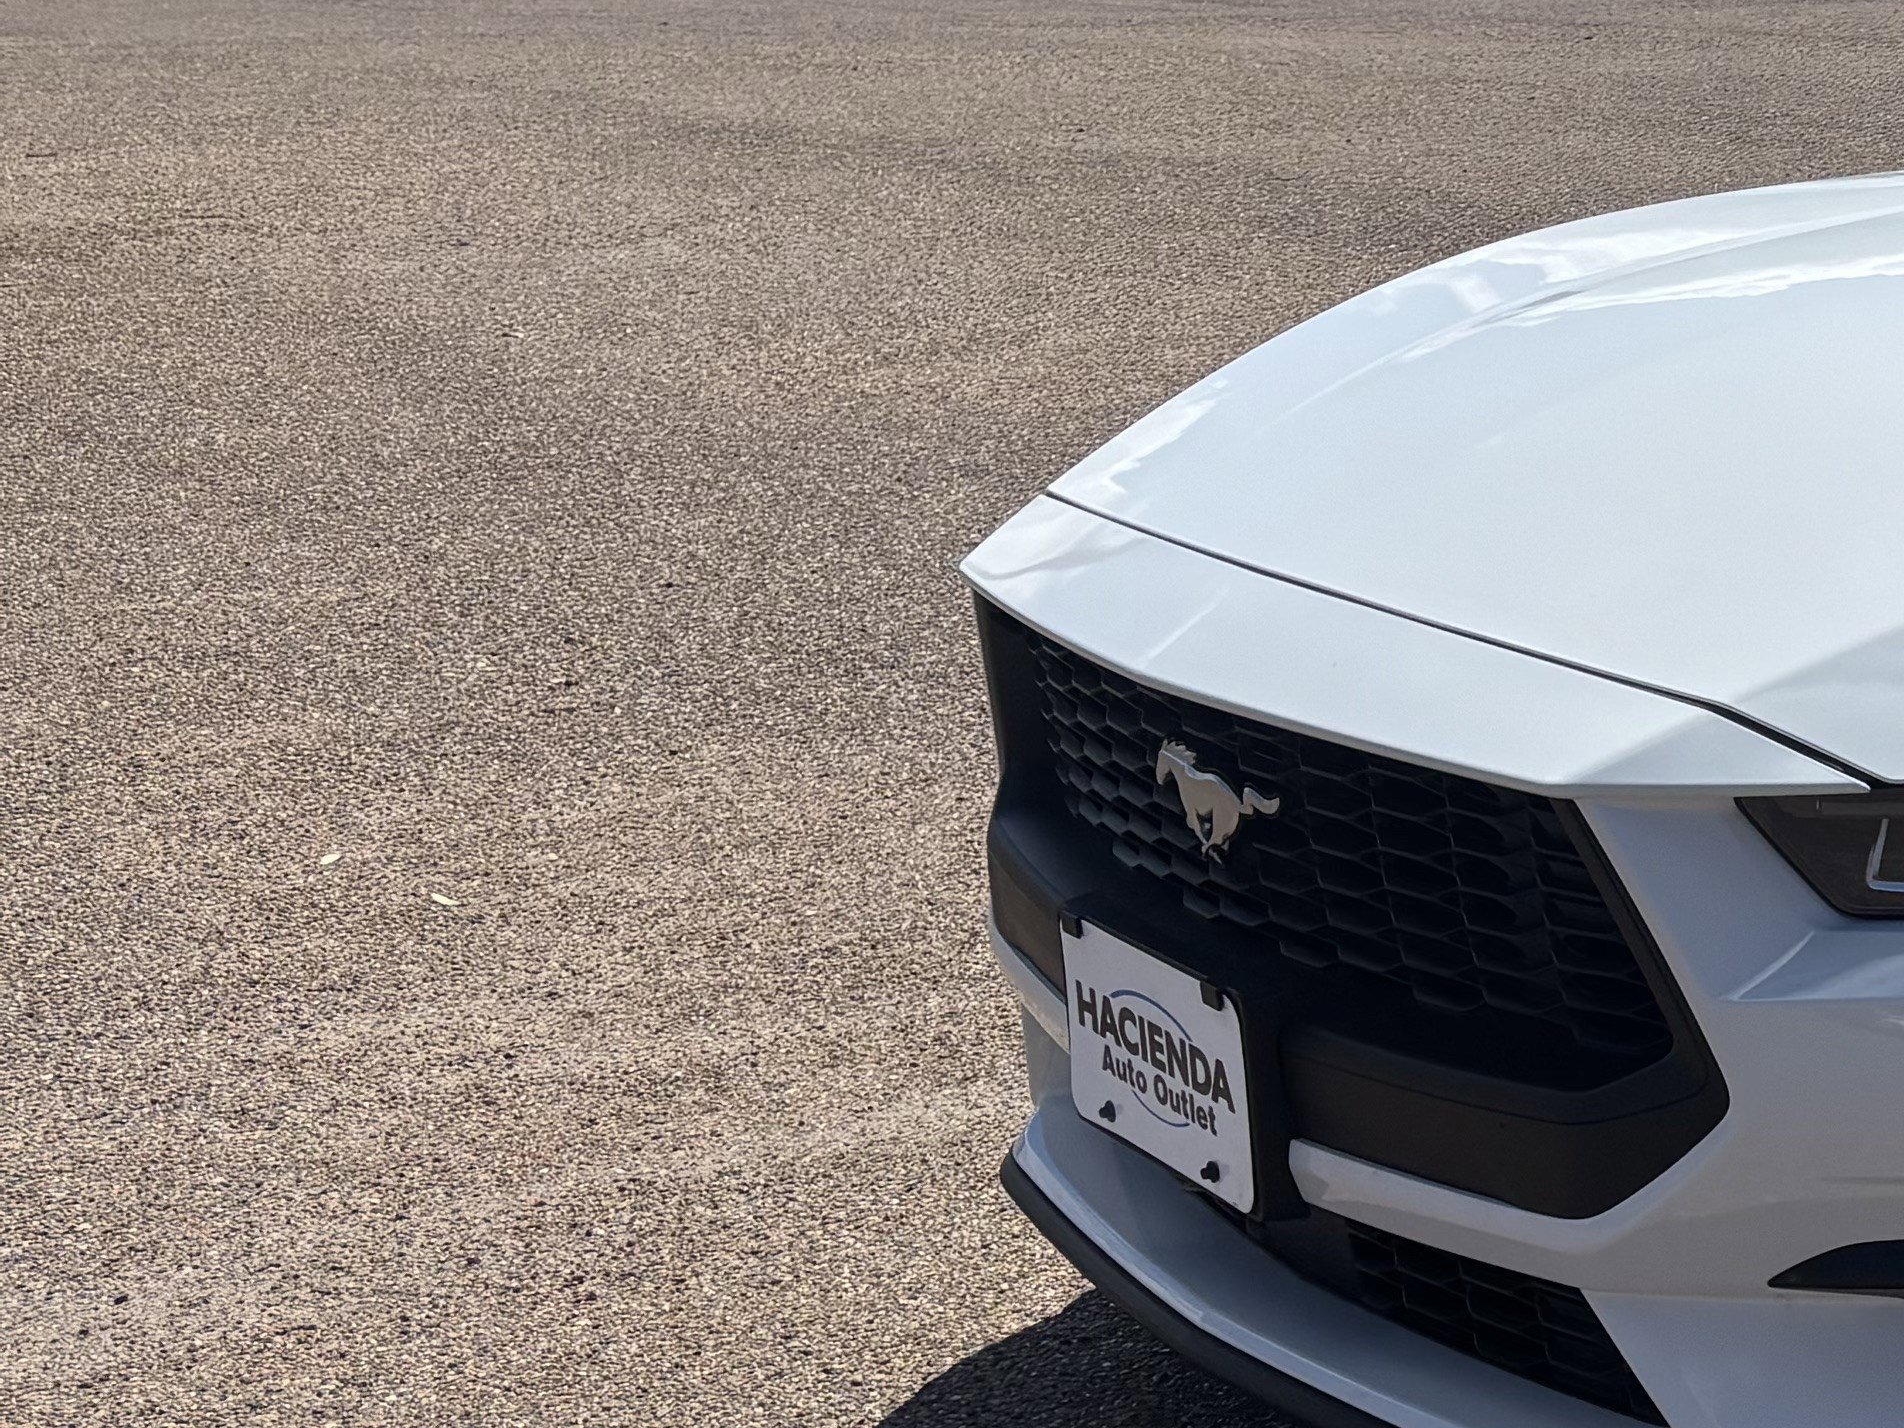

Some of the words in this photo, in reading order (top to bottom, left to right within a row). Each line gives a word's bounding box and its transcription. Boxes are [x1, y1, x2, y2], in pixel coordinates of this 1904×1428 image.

[1075, 979, 1236, 1114] HACIENDA
[1101, 1044, 1148, 1095] Auto
[1153, 1074, 1218, 1137] Outlet
